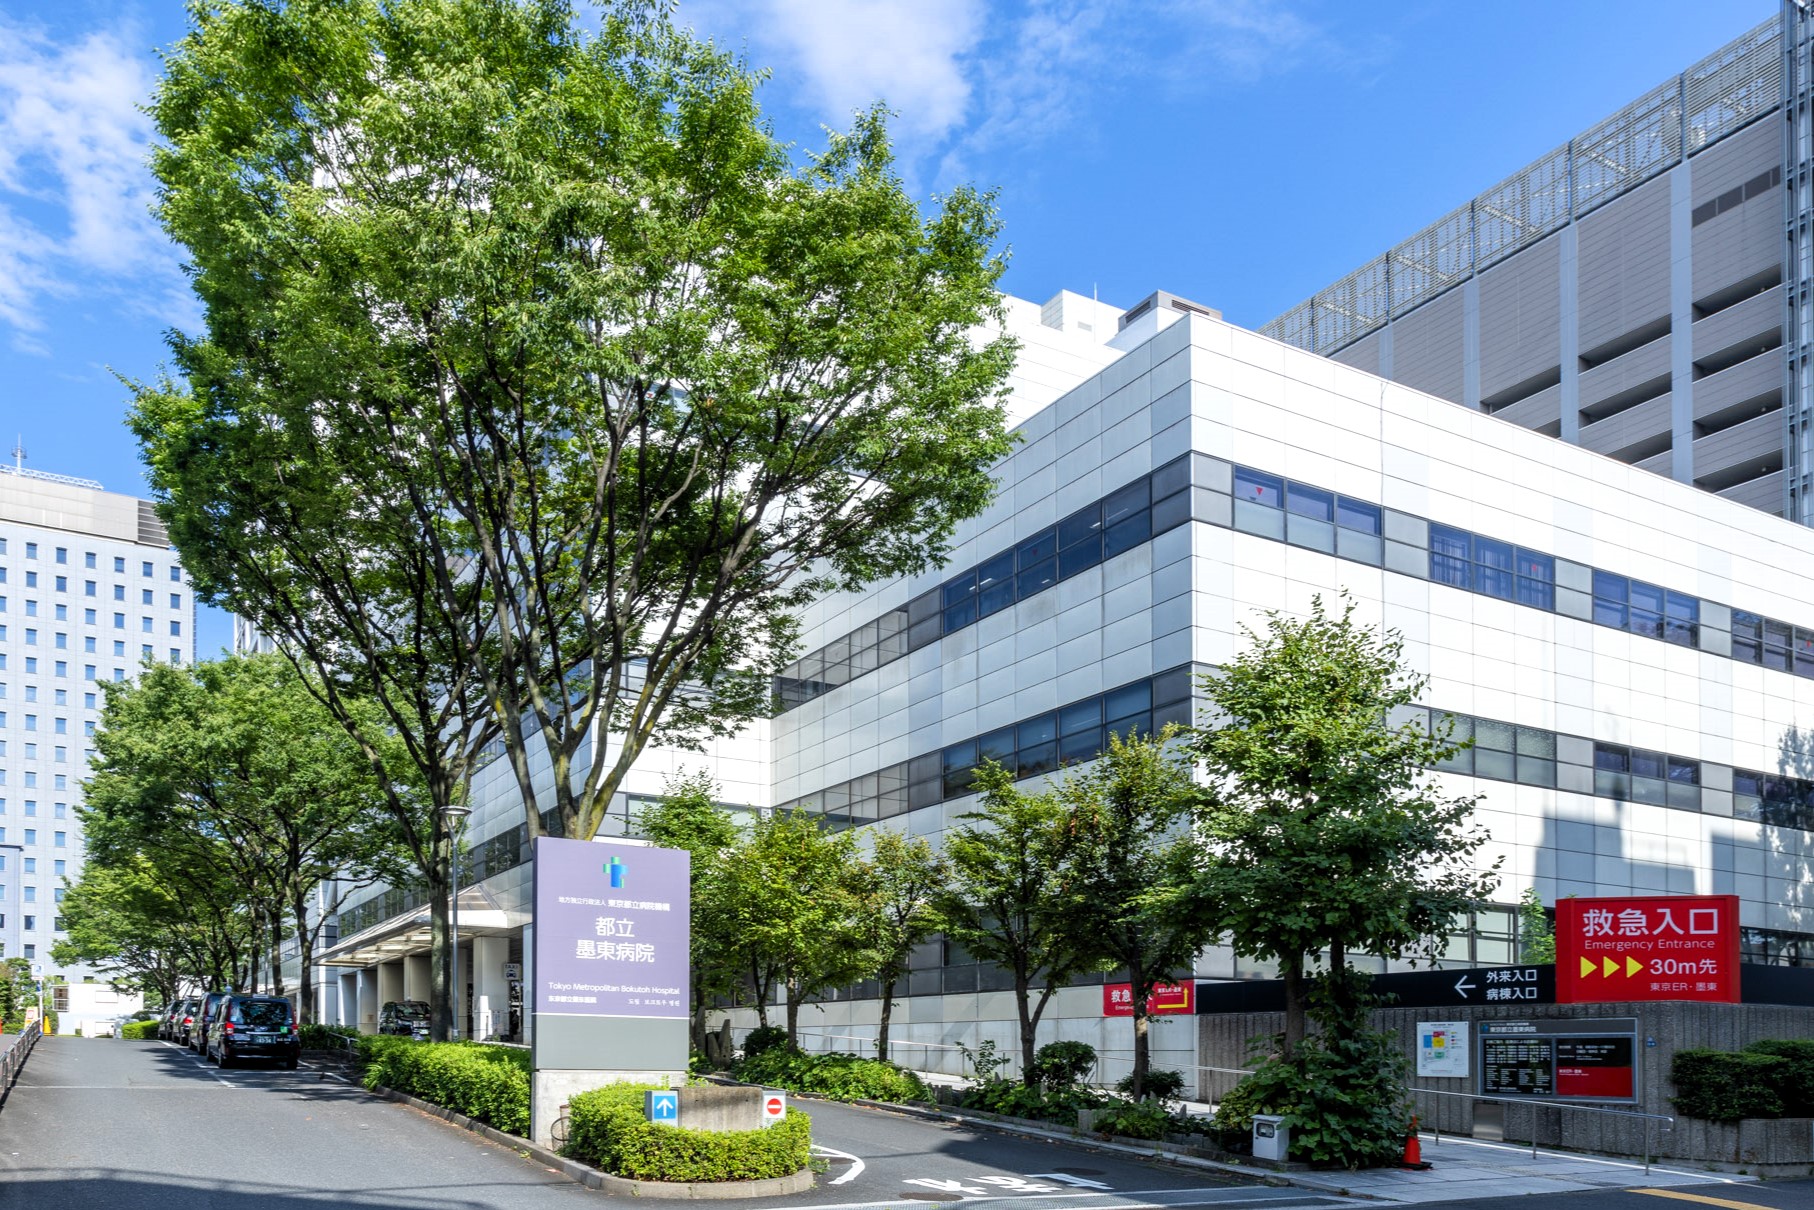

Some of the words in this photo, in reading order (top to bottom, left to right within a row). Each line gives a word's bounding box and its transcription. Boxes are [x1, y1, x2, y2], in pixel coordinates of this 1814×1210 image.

[595, 916, 636, 938] 都立
[1582, 908, 1719, 937] 救急入口
[575, 939, 656, 963] 墨東病院
[1584, 939, 1655, 951] Emergency
[1658, 938, 1716, 949] Entrance
[1650, 957, 1718, 975] 30m先
[1486, 969, 1538, 983] 外来入口
[548, 982, 573, 991] Tokyo
[573, 983, 620, 993] Metropolitan
[620, 986, 651, 994] Bokutoh
[651, 987, 681, 996] Hospital
[1486, 986, 1538, 1001] 病棟入口
[902, 1173, 1114, 1195] 止まれ
